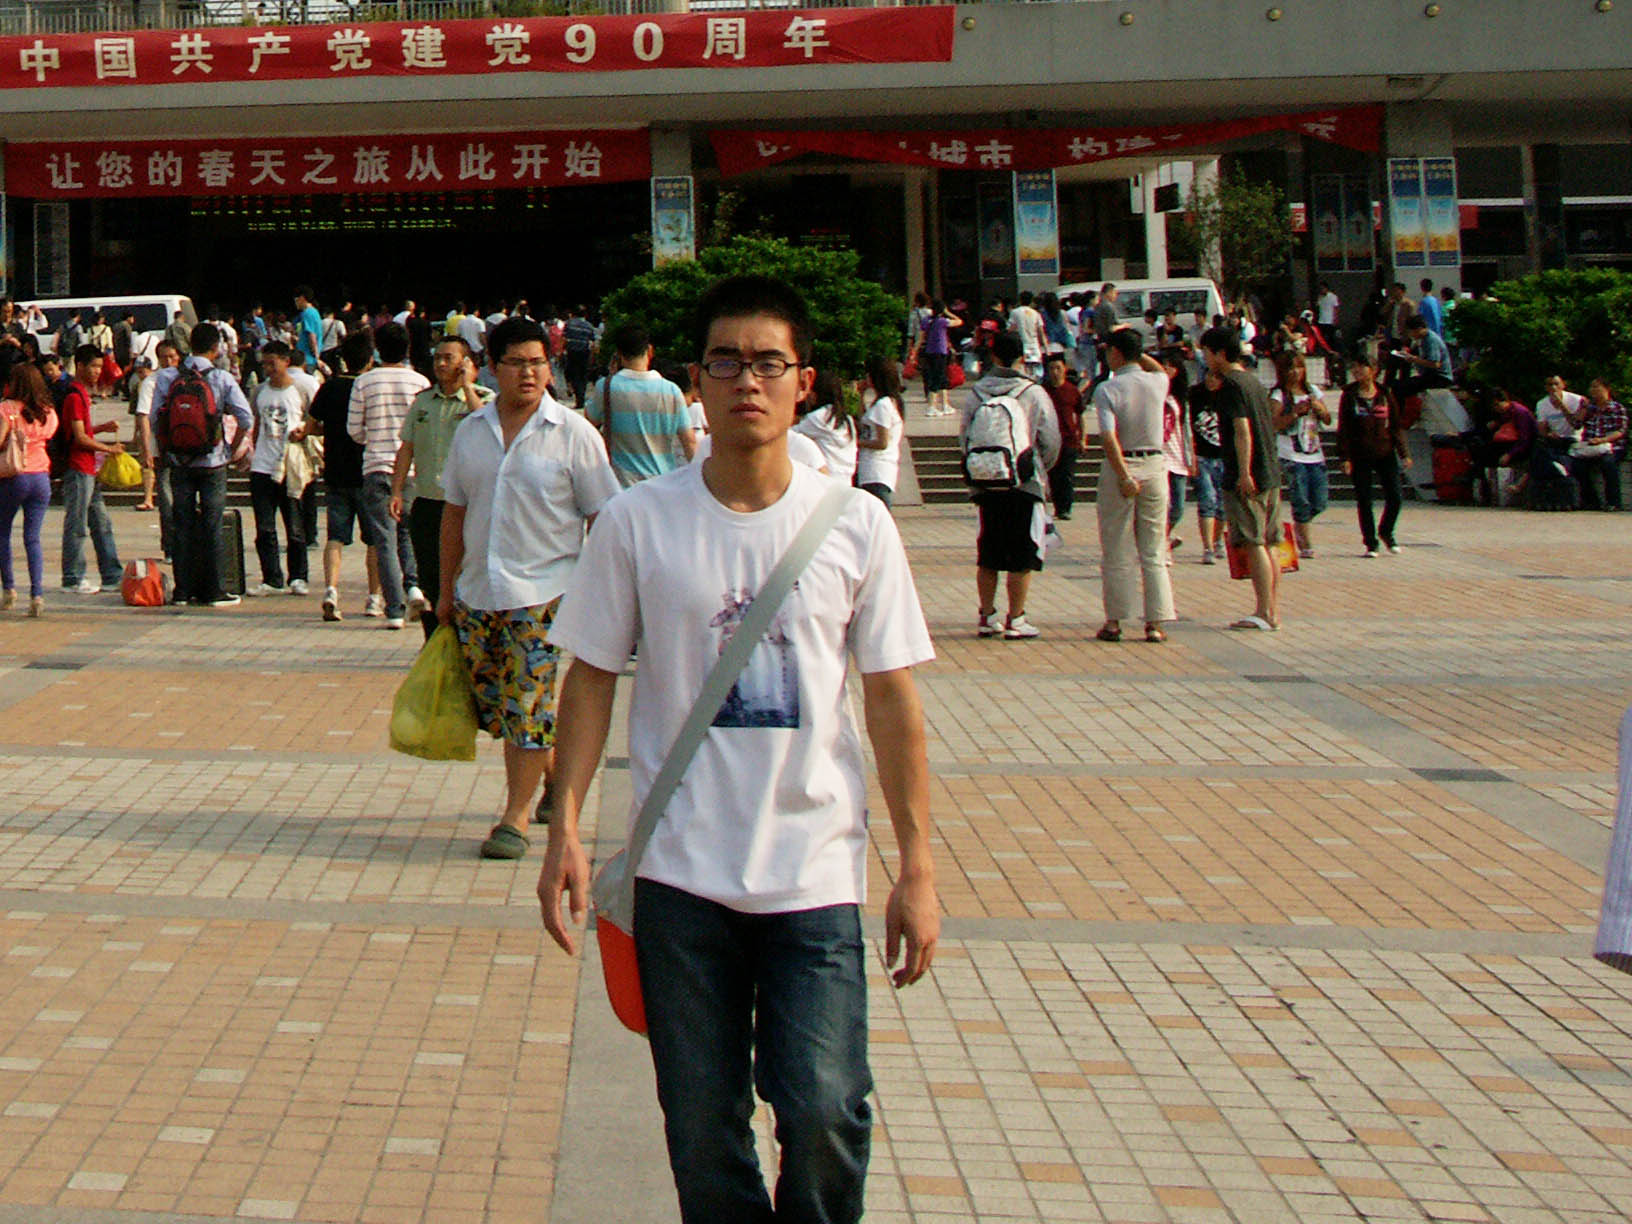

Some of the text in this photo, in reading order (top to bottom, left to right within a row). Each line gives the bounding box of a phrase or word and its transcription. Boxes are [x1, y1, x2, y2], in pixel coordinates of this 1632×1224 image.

[46, 143, 603, 190] 让您的春天之旅从此开始
